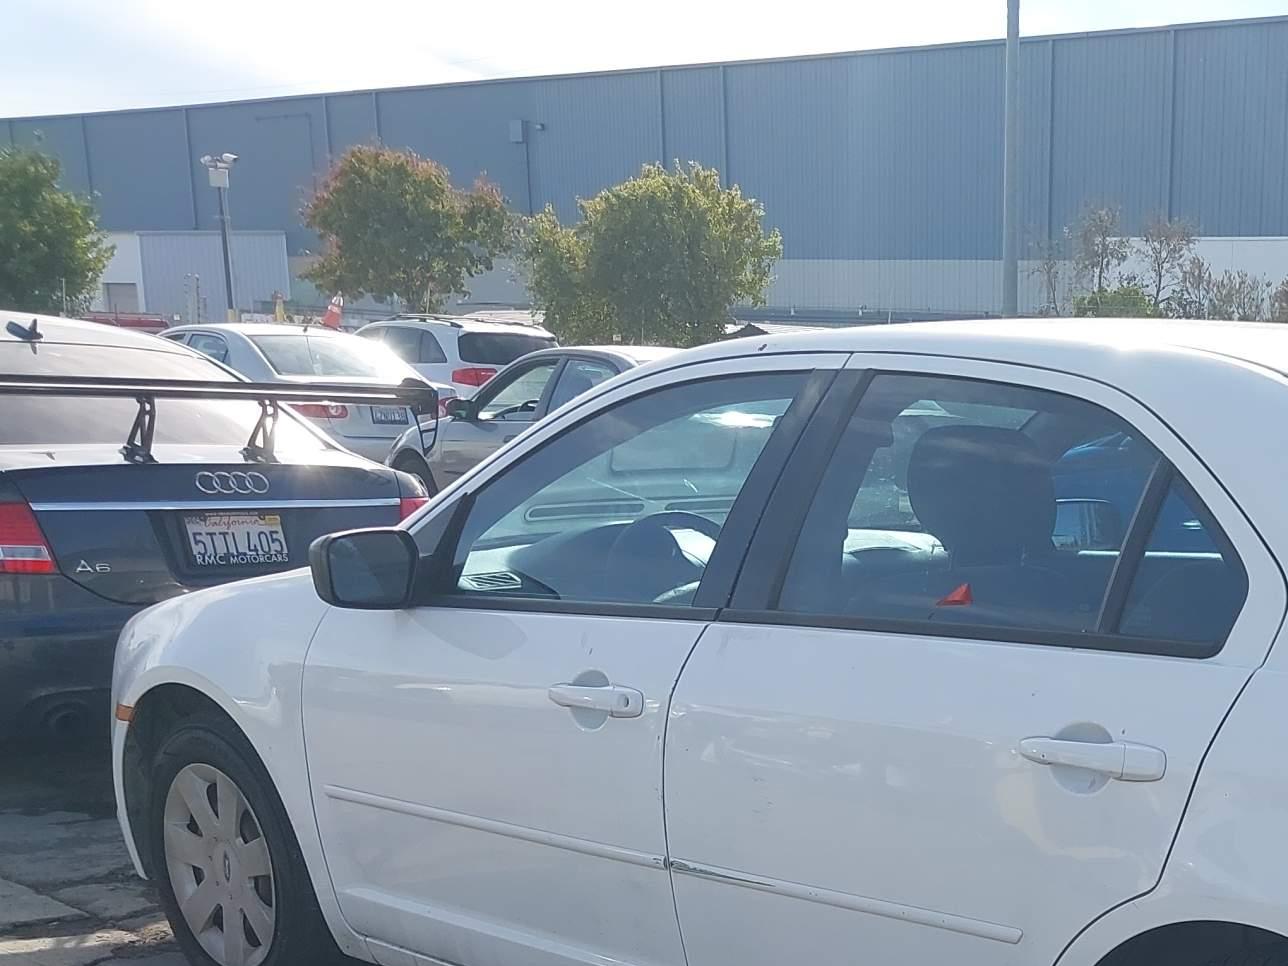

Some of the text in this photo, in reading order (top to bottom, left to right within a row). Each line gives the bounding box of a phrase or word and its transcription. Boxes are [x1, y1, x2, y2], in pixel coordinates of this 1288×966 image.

[204, 515, 260, 531] California
[196, 553, 289, 565] RMC MOTORCARS
[76, 560, 111, 573] A6
